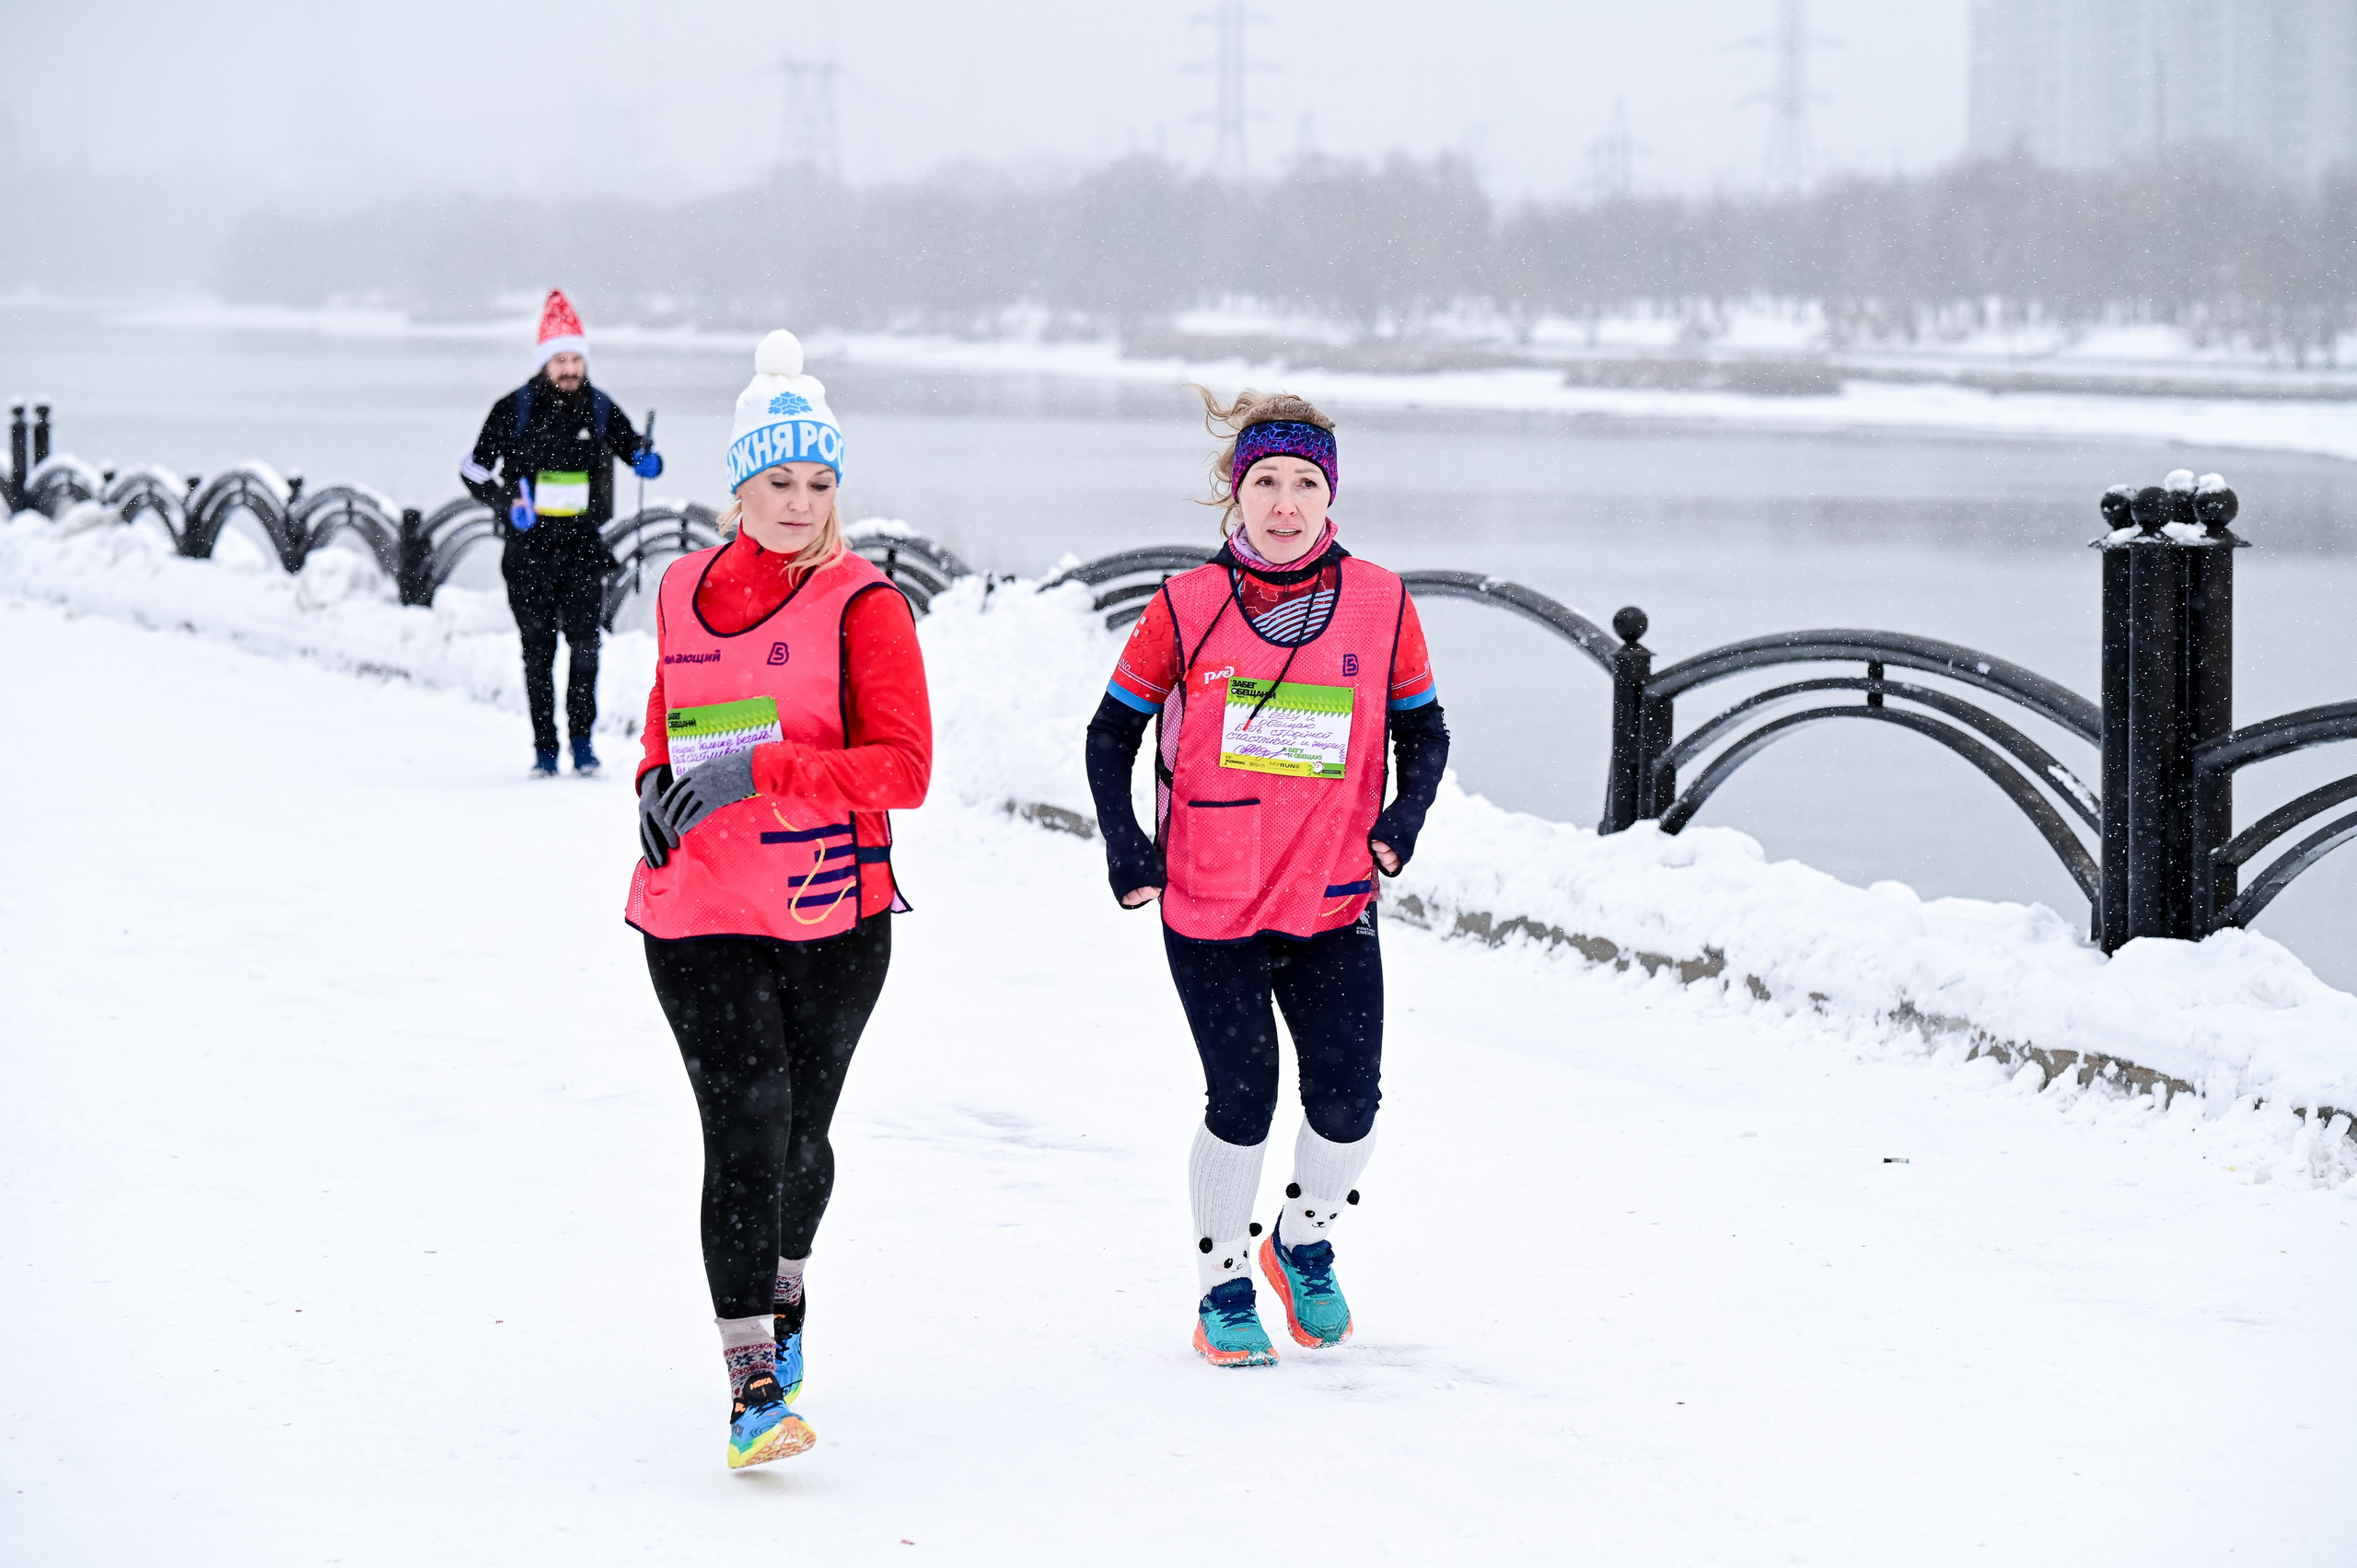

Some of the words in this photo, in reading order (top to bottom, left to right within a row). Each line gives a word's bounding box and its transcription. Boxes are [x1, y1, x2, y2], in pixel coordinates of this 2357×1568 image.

[1231, 679, 1258, 689] ЗАБЕГ
[1230, 687, 1277, 700] ОБЕЩАНЙ
[1234, 722, 1263, 734] Бть
[1220, 1283, 1243, 1295] HOKA
[749, 1376, 773, 1390] HOKA
